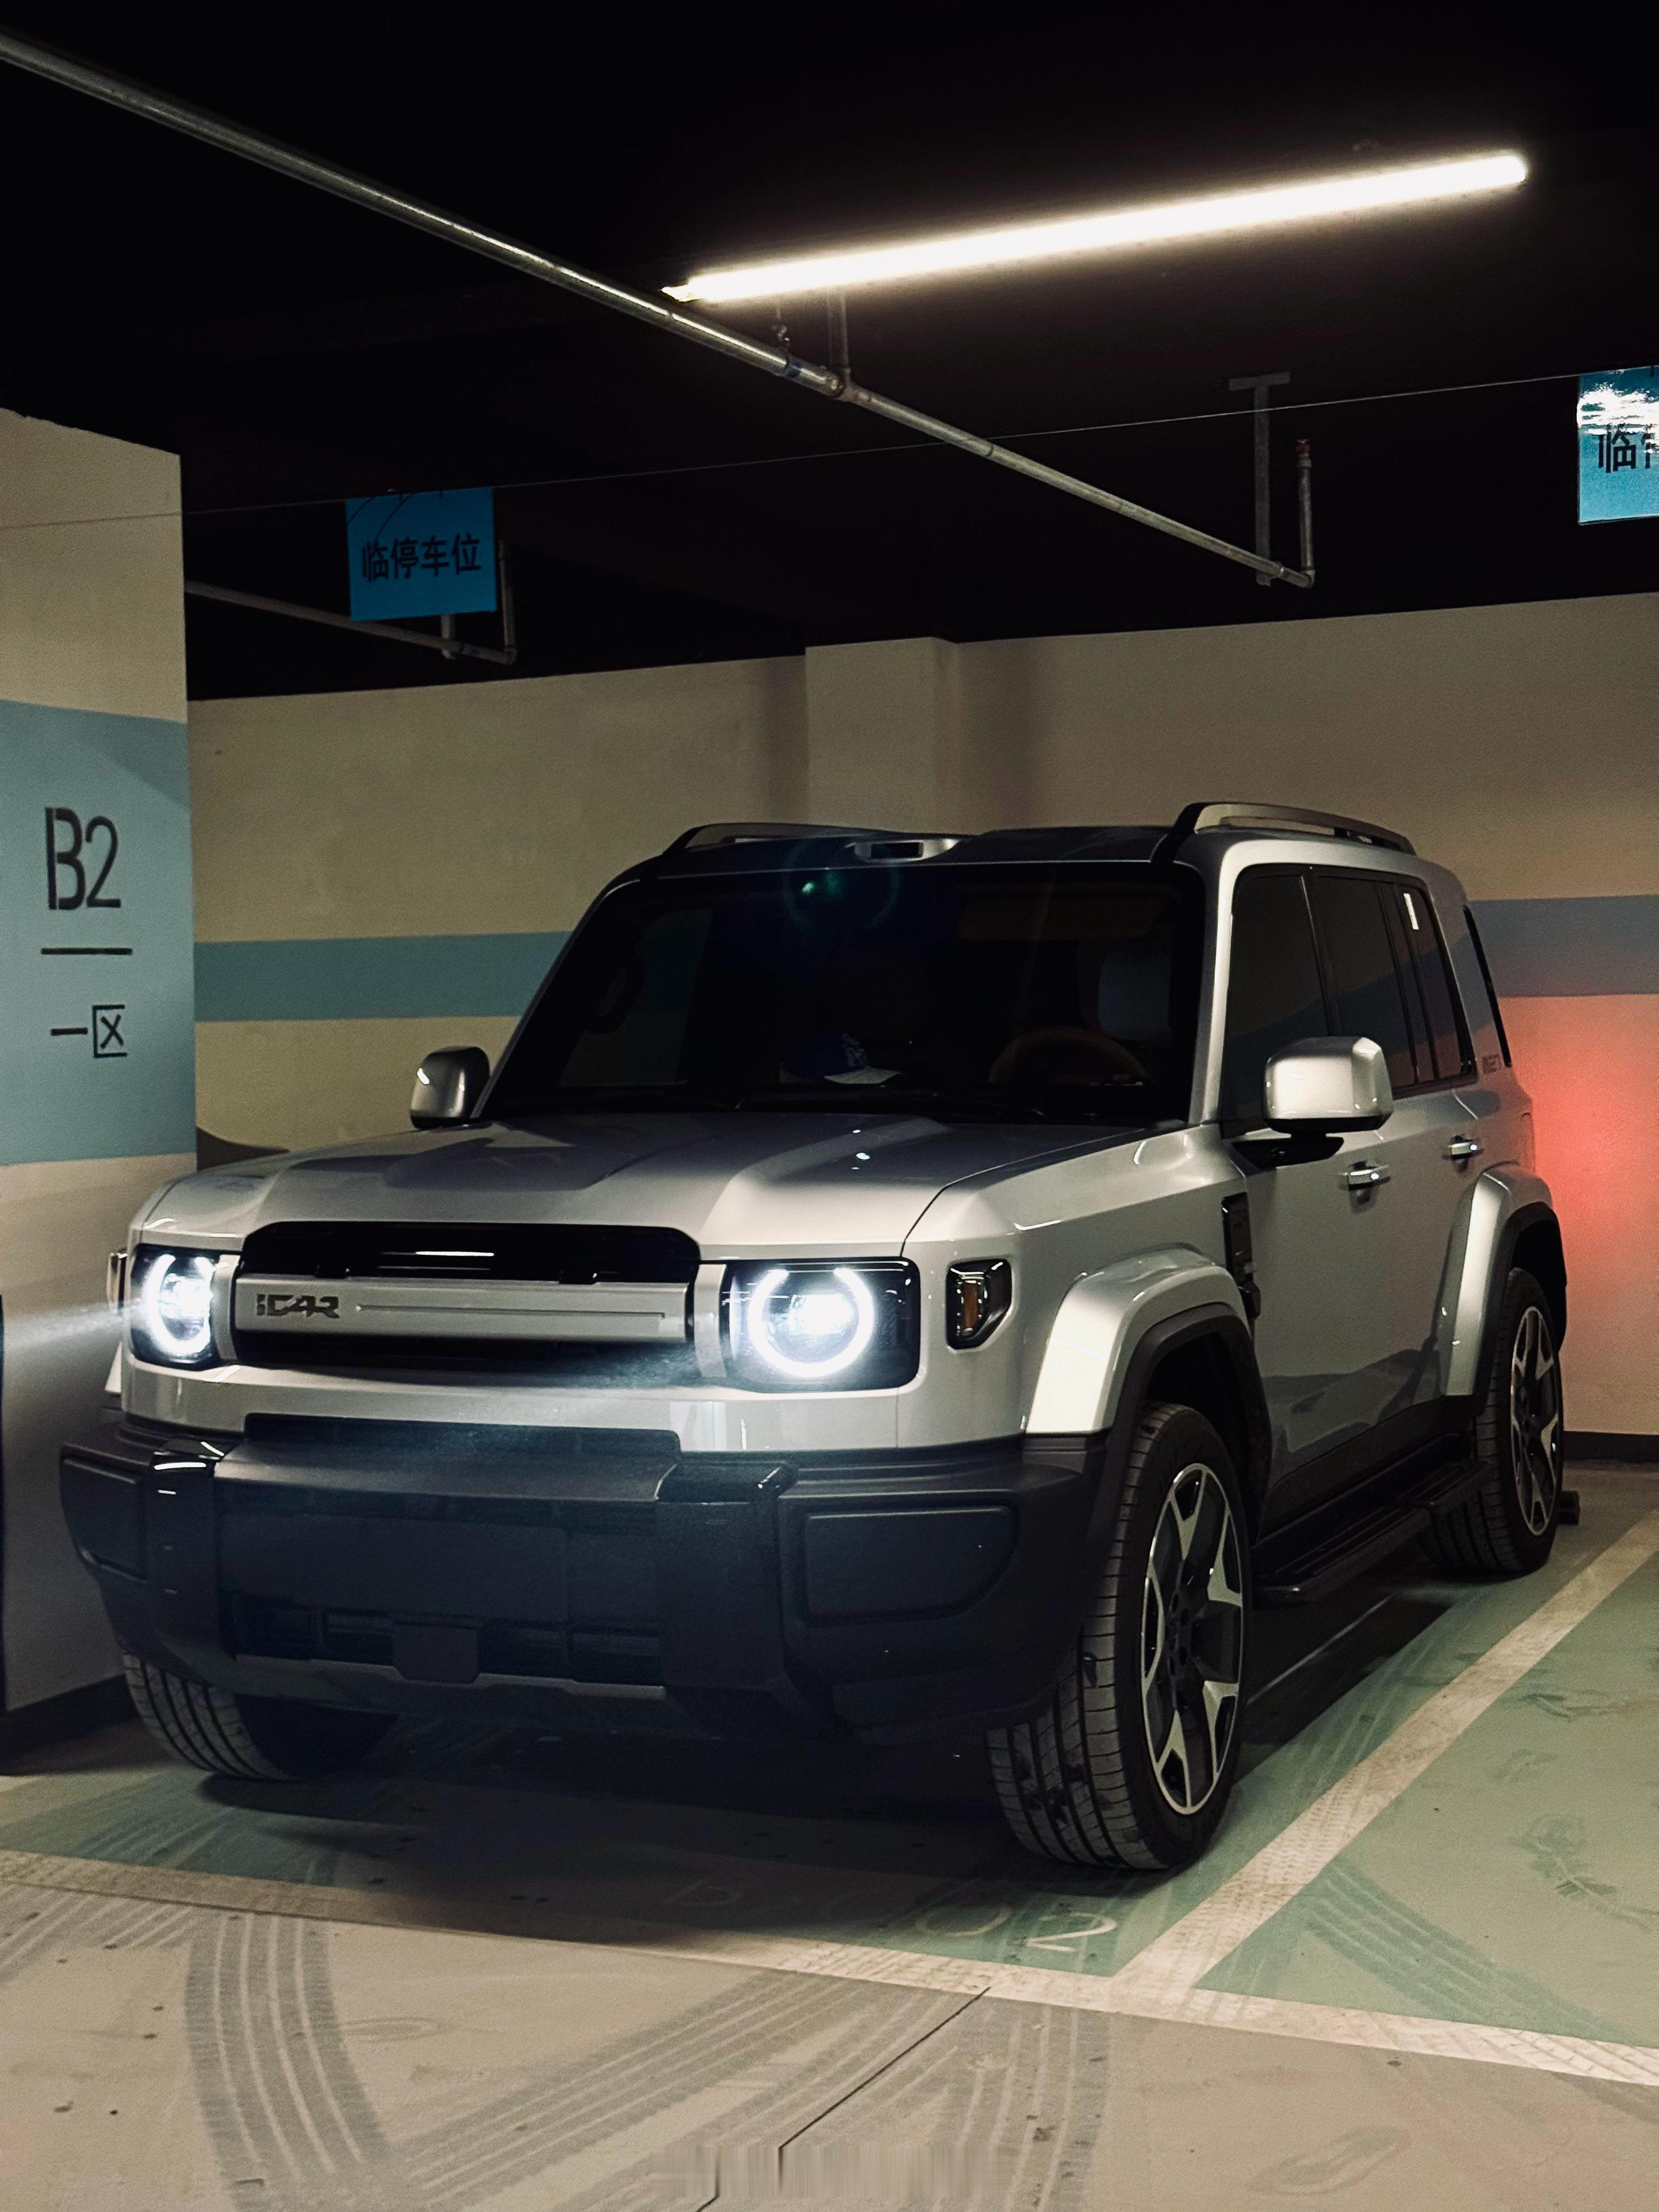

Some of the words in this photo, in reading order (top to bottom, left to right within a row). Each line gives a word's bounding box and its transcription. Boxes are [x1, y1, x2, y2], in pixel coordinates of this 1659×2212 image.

[362, 532, 482, 583] 临停车位
[45, 807, 121, 910] B2
[50, 1005, 128, 1059] 一区
